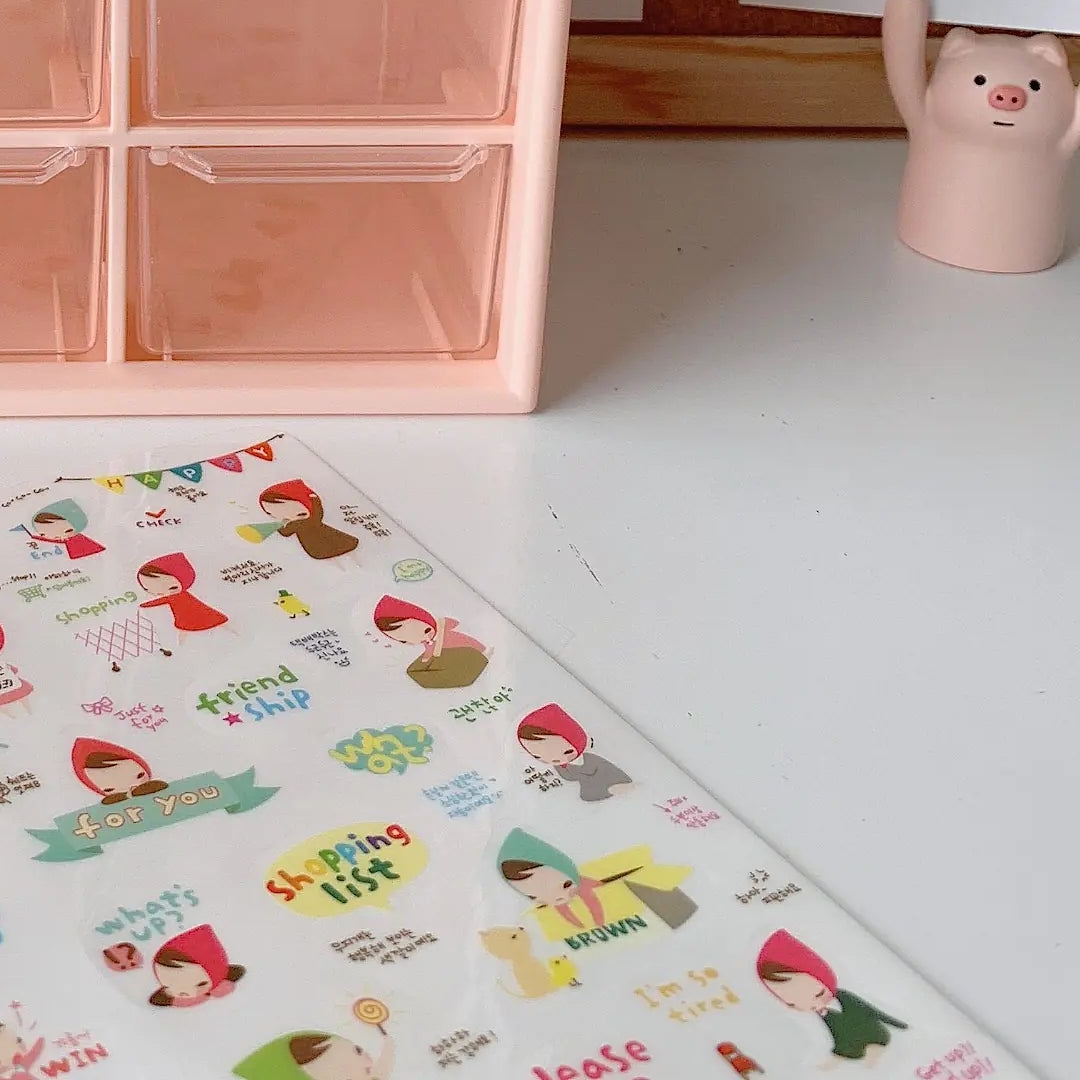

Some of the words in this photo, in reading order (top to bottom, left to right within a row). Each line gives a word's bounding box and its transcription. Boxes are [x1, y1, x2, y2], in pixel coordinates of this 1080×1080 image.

[136, 517, 182, 529] CHECK
[195, 664, 299, 716] friend
[244, 687, 312, 722] ship
[73, 806, 145, 840] for
[153, 785, 220, 817] you
[320, 857, 401, 904] list
[94, 883, 200, 936] what's
[130, 909, 184, 942] up?
[563, 913, 648, 951] BROWN
[633, 981, 684, 1008] I'm
[668, 984, 740, 1023] tired
[40, 1042, 109, 1078] WIN
